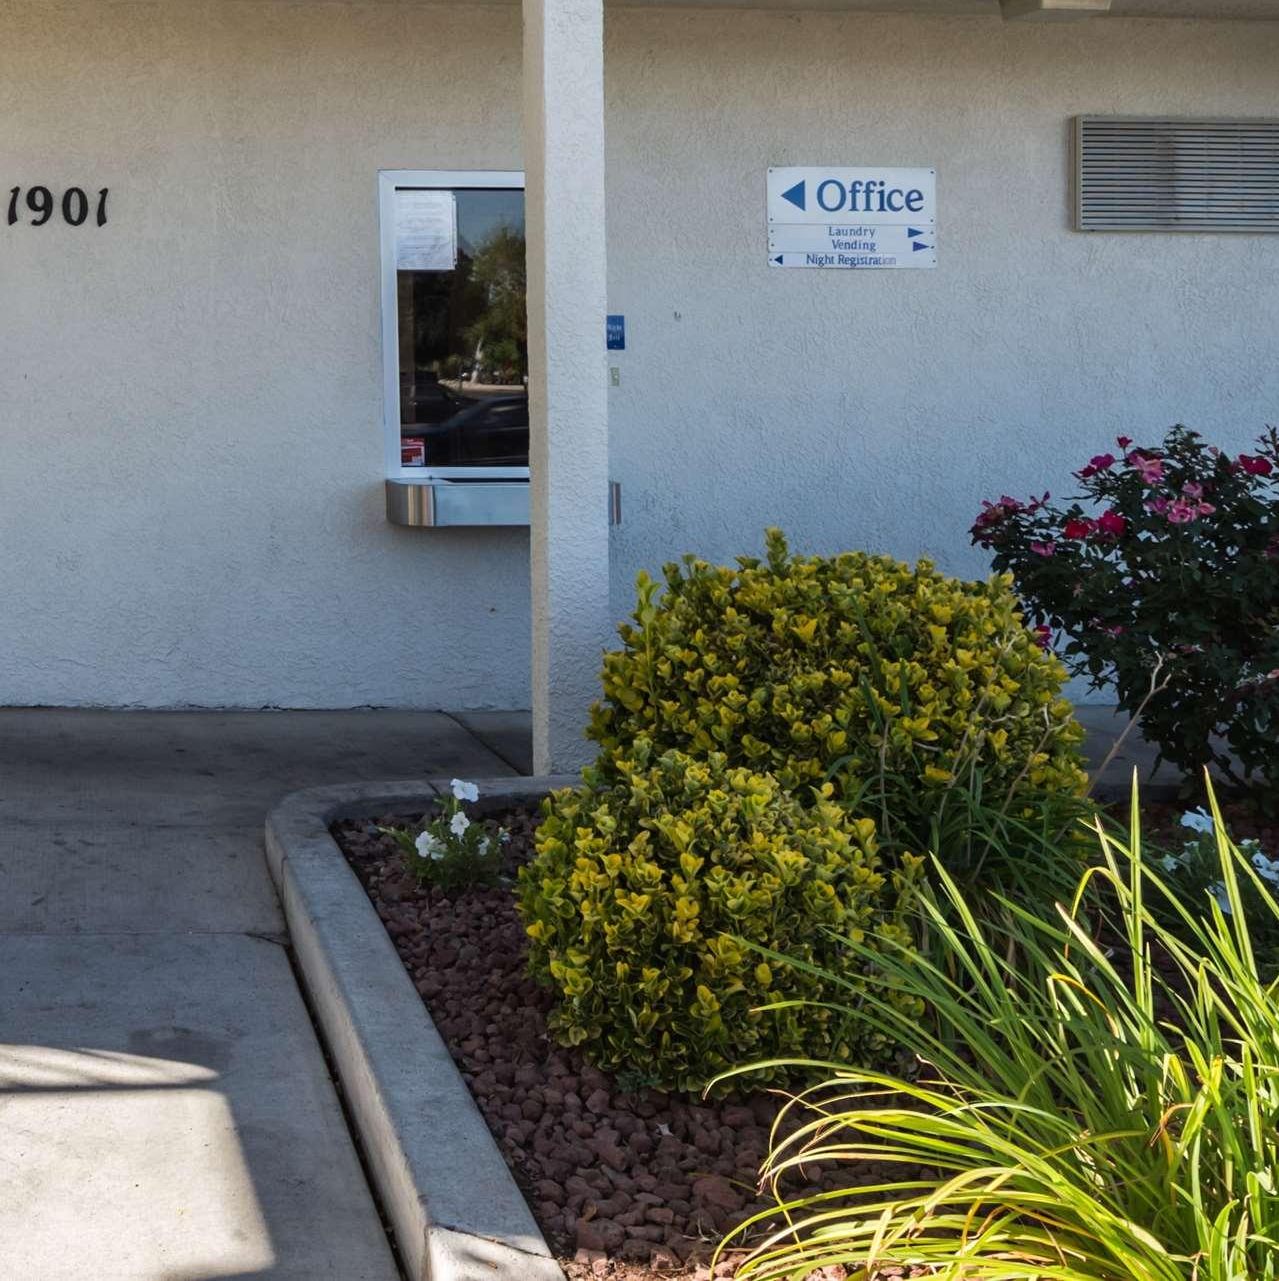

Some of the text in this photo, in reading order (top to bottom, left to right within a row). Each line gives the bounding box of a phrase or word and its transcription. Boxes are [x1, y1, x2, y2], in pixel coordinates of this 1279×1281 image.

[816, 179, 925, 212] Office
[7, 185, 110, 228] 1901
[828, 226, 876, 239] Laundry
[831, 239, 877, 252] Vending
[806, 254, 897, 267] Night Registration
